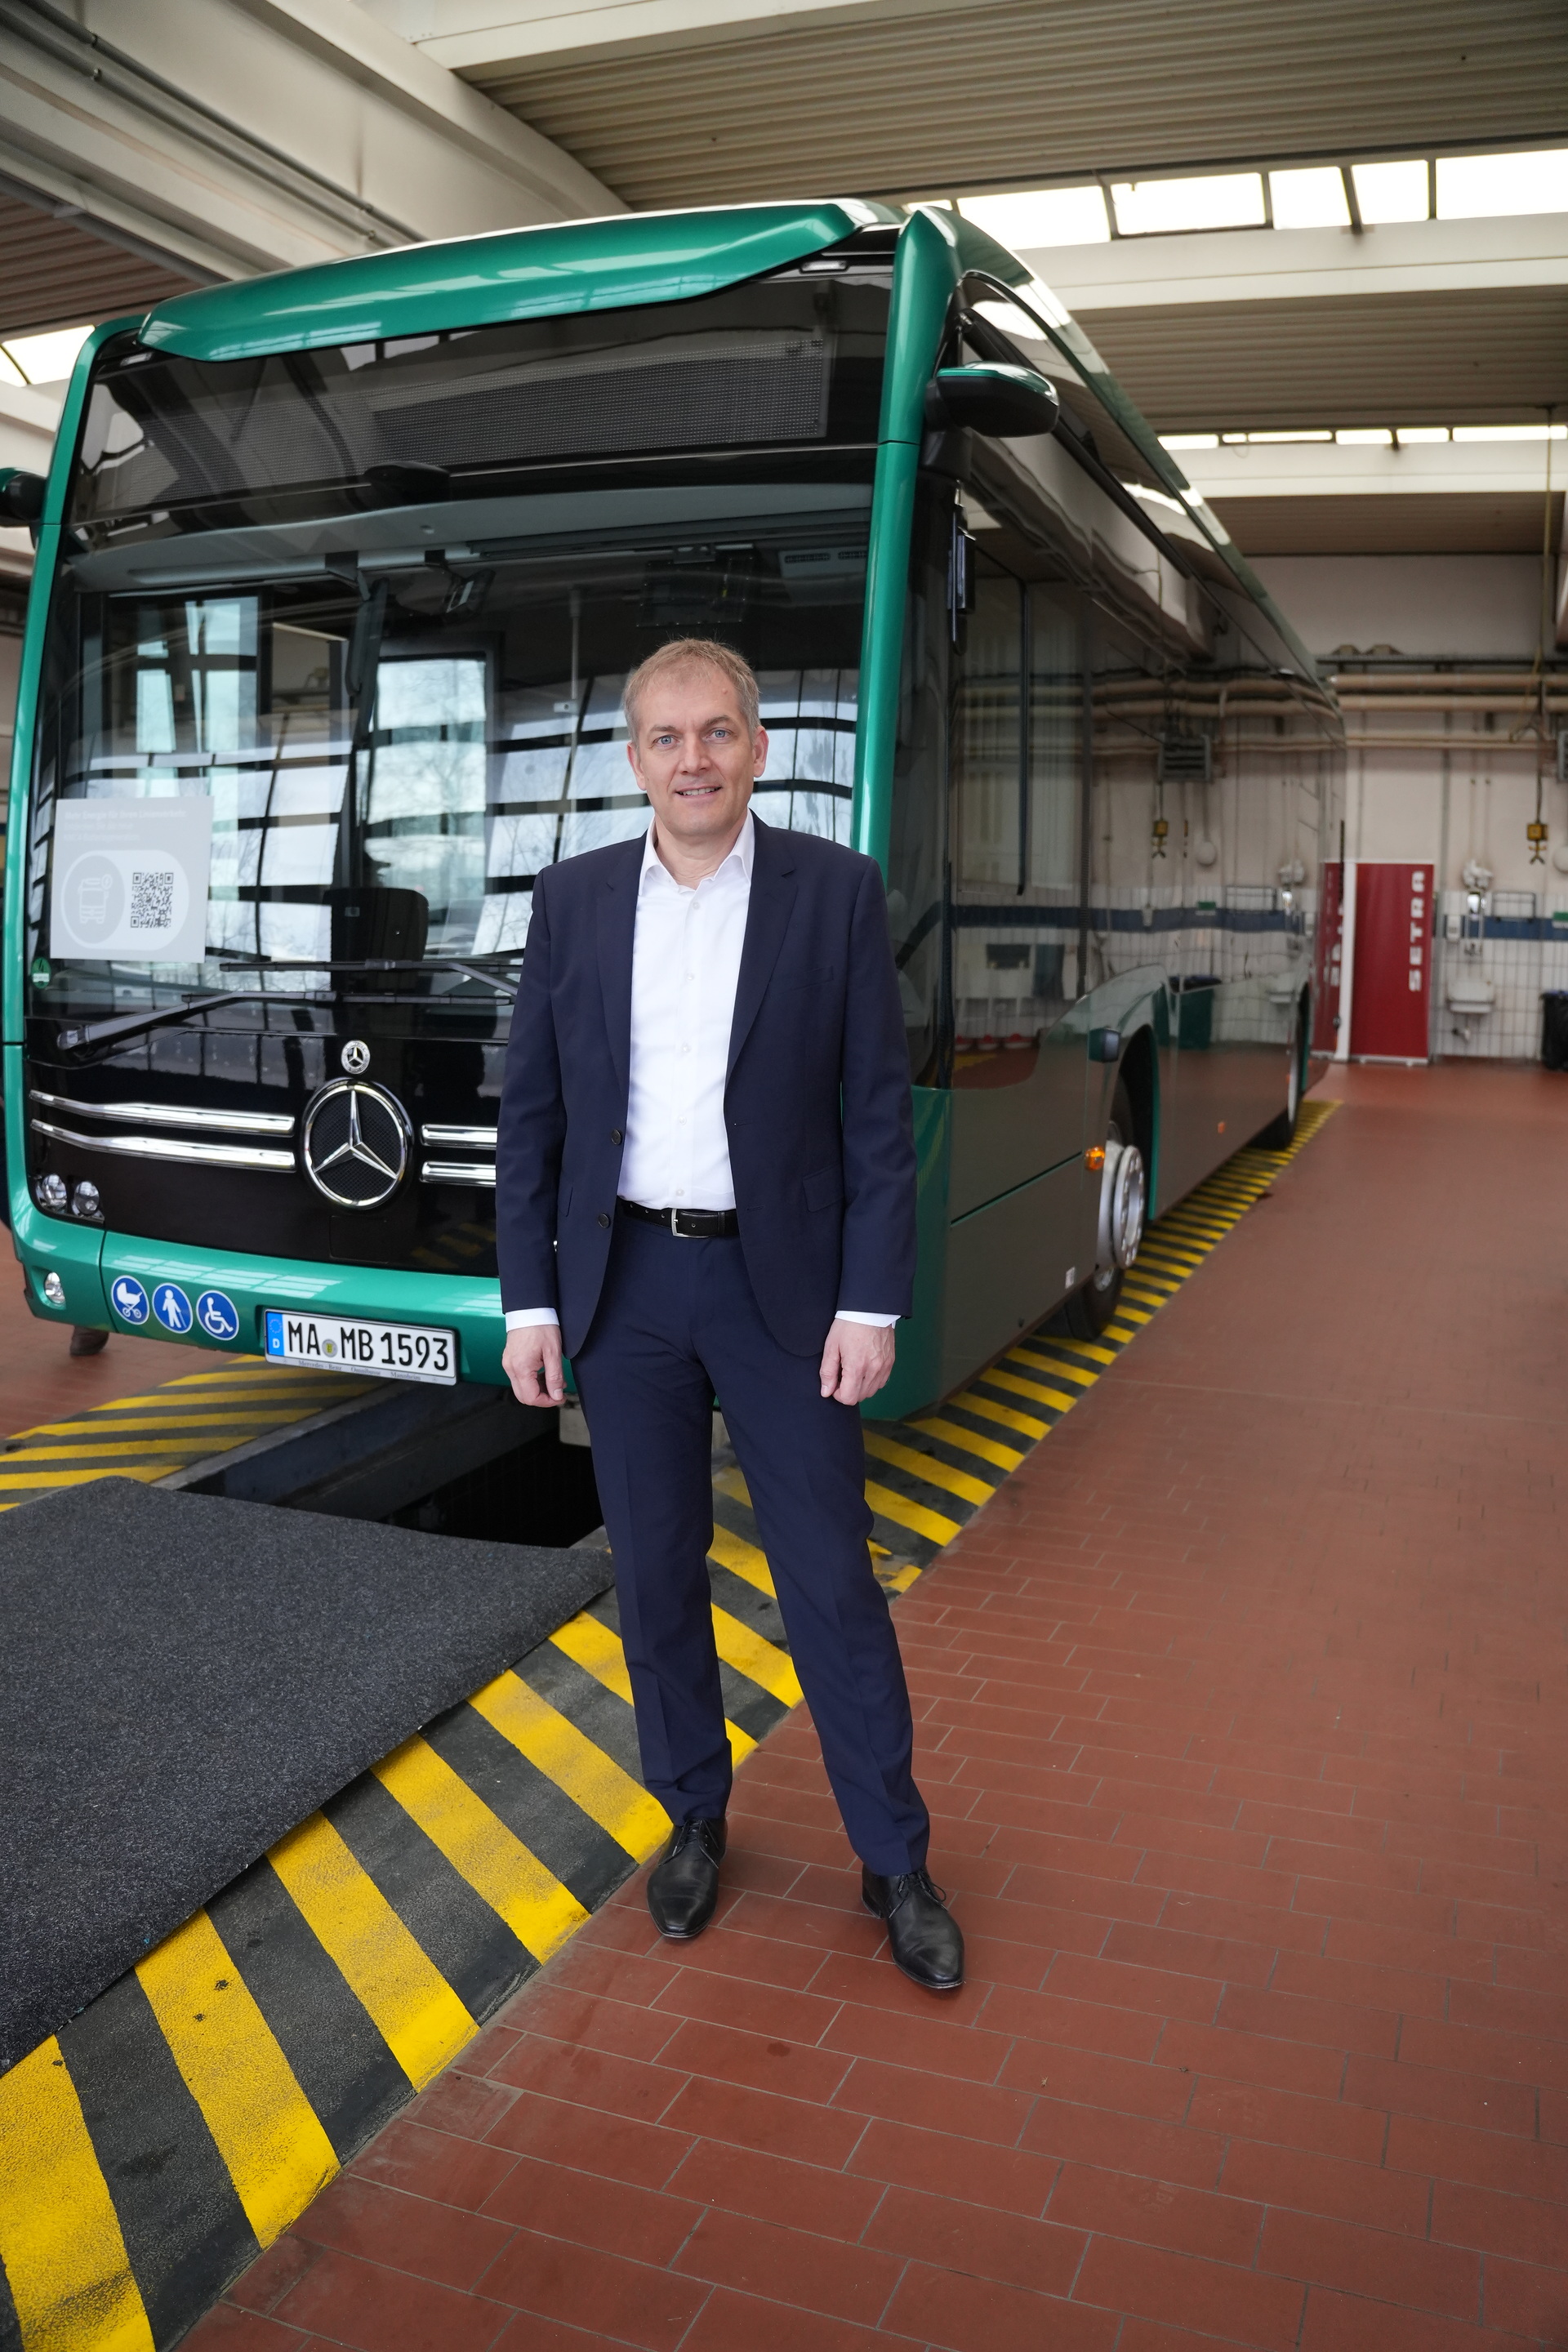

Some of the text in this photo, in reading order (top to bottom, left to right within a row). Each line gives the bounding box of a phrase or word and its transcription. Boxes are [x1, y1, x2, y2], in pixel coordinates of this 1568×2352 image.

[1409, 871, 1425, 991] SETRA
[272, 1338, 280, 1348] D
[288, 1321, 448, 1370] MA MB 1593
